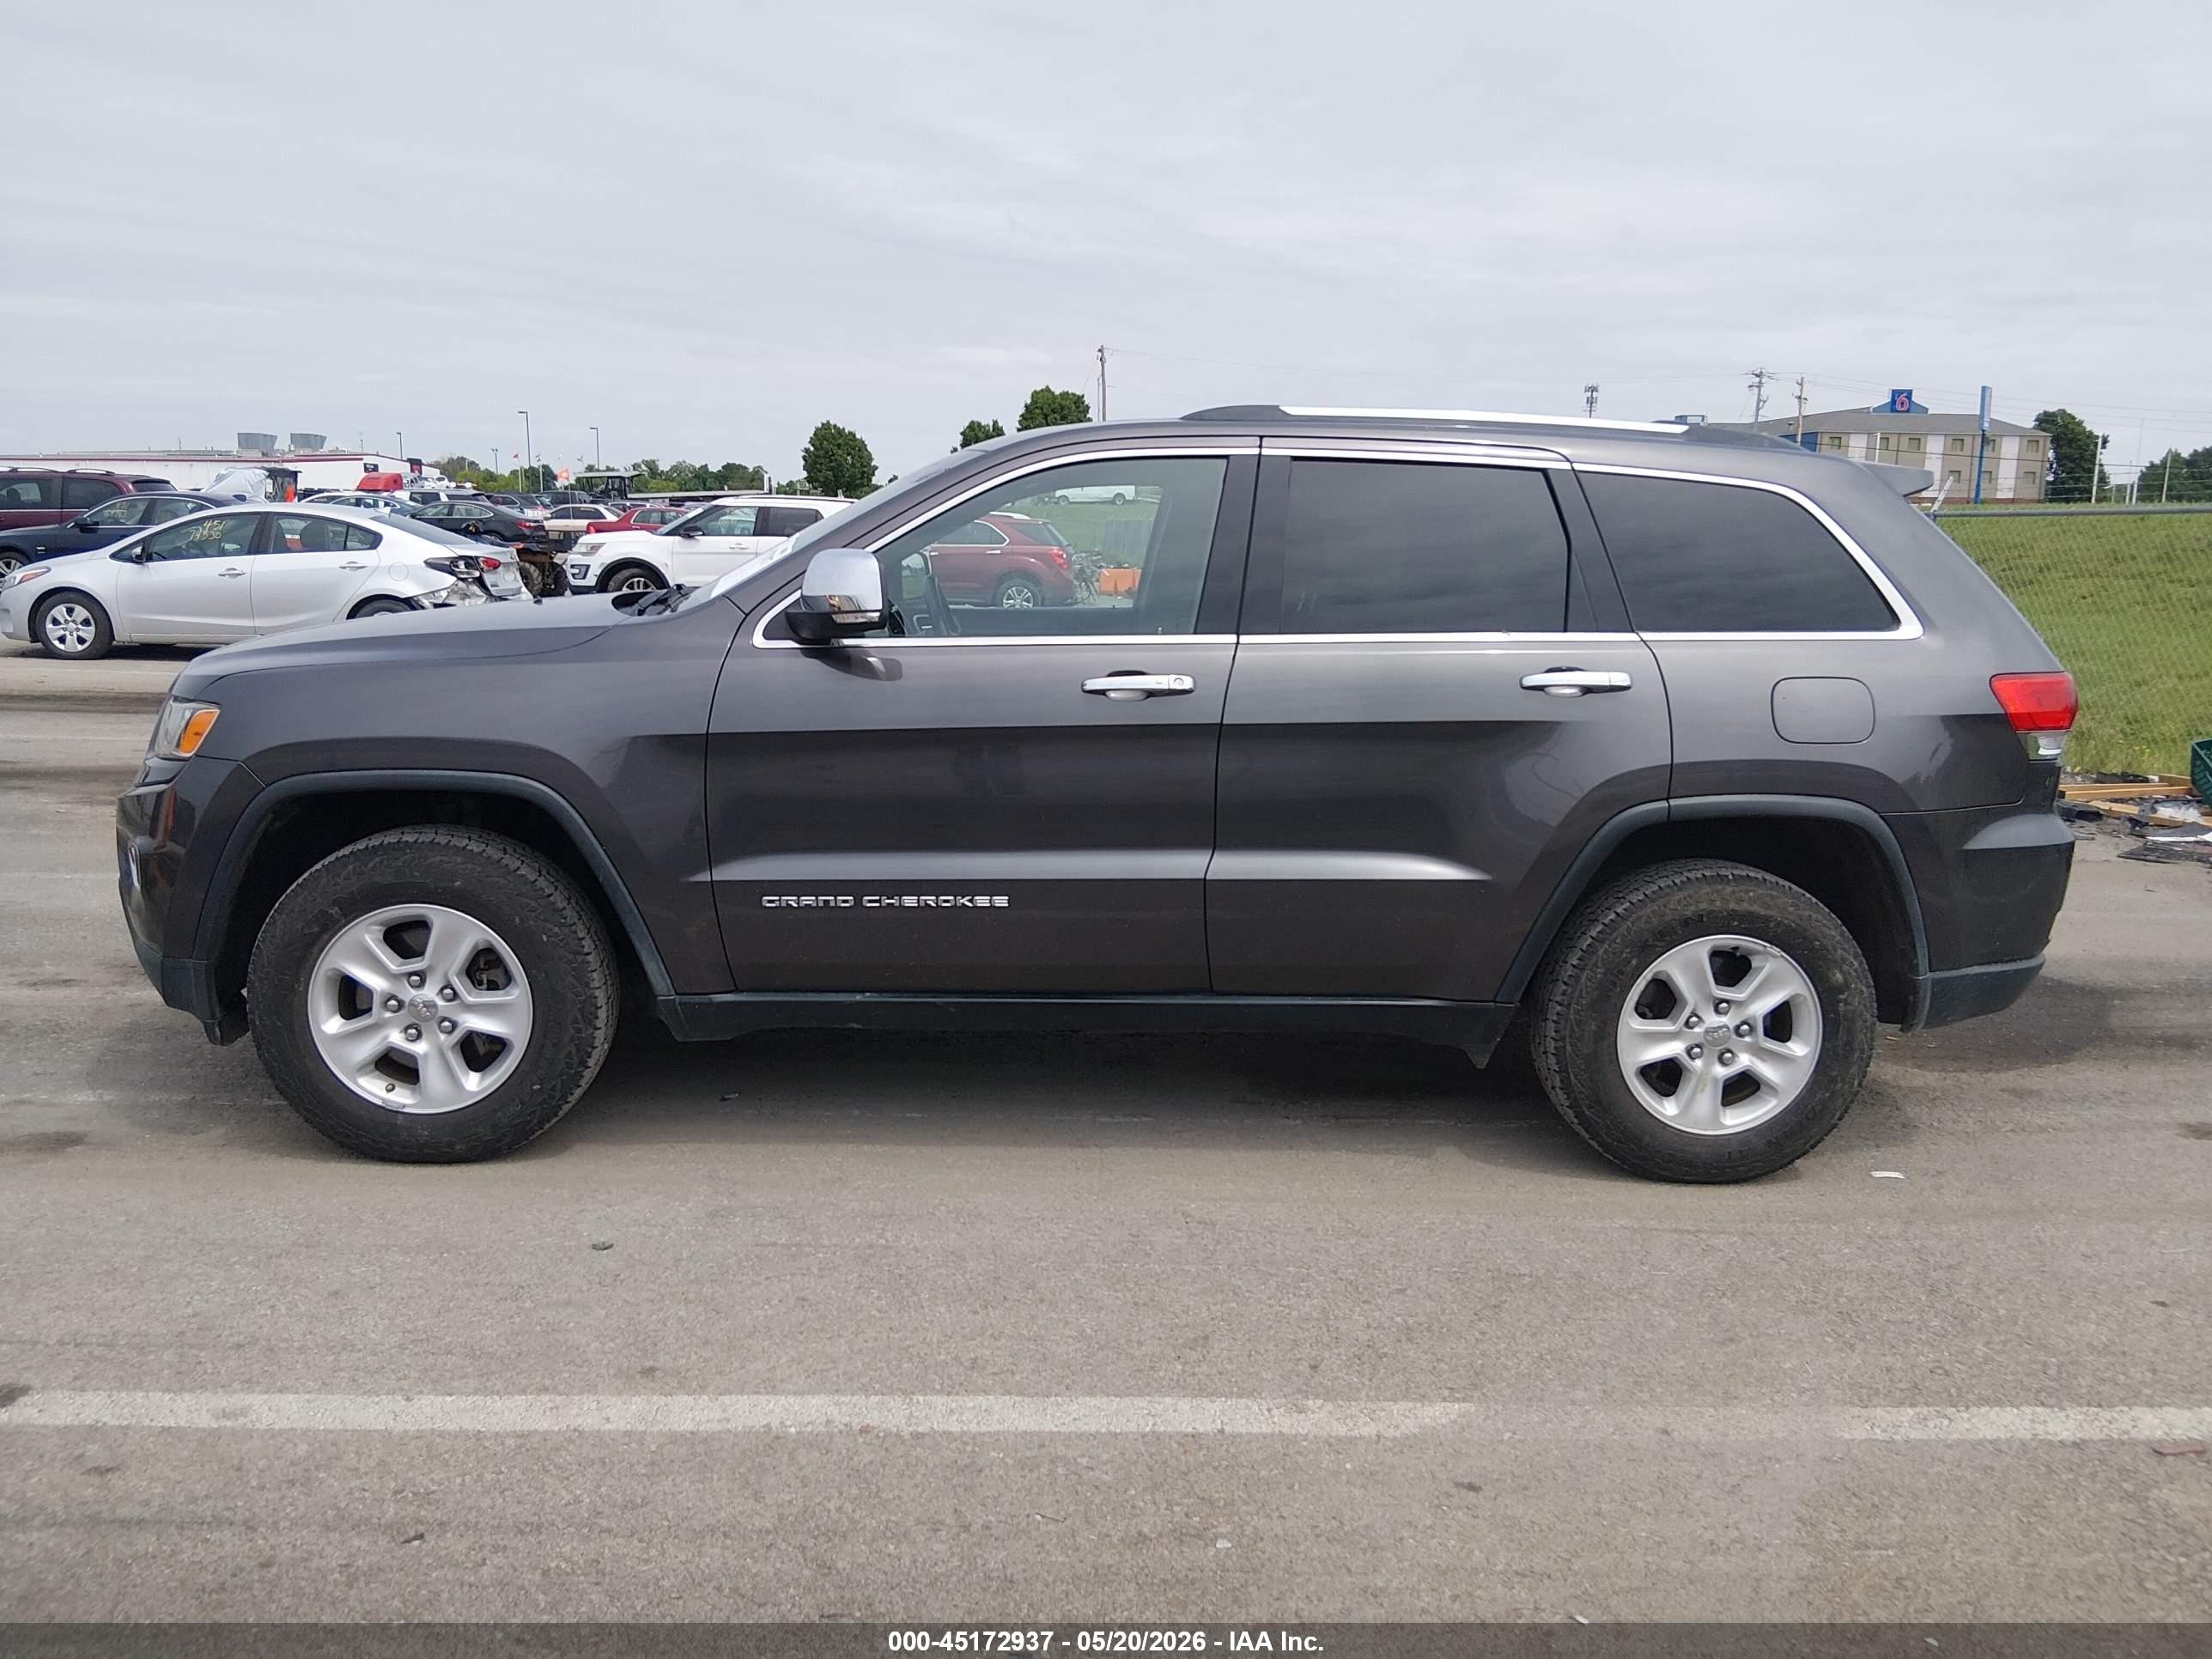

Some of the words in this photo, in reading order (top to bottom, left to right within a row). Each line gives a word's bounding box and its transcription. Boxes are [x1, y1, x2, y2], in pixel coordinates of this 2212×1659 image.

[1896, 392, 1909, 411] 6
[763, 896, 854, 907] GRAND
[863, 896, 1009, 907] CHEROKEE
